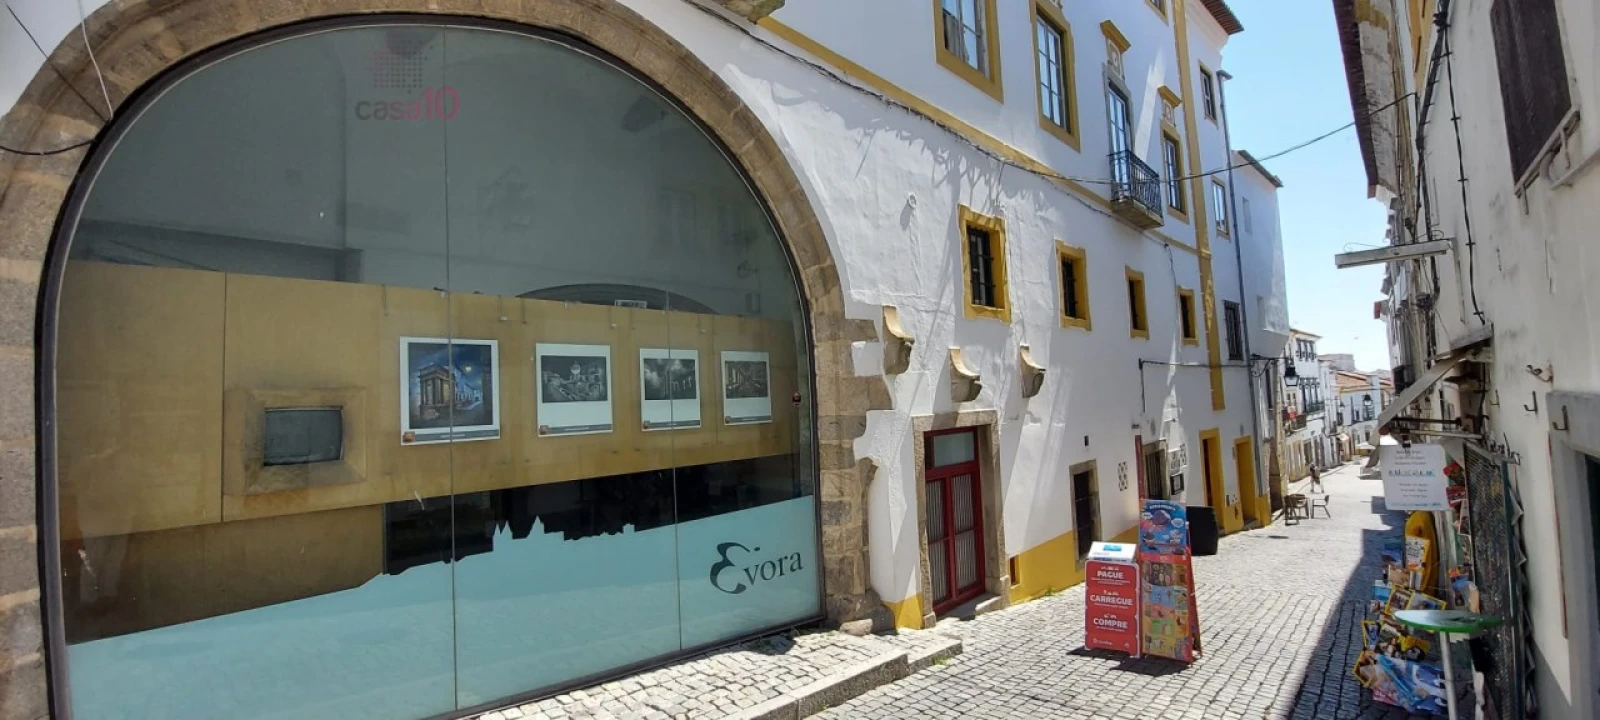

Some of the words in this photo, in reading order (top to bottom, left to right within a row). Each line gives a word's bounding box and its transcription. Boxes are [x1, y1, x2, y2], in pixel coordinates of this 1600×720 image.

[355, 86, 460, 121] casa10
[1096, 571, 1124, 580] PAGUE
[1089, 594, 1133, 606] CARREGUE
[1093, 618, 1129, 629] COMPRE
